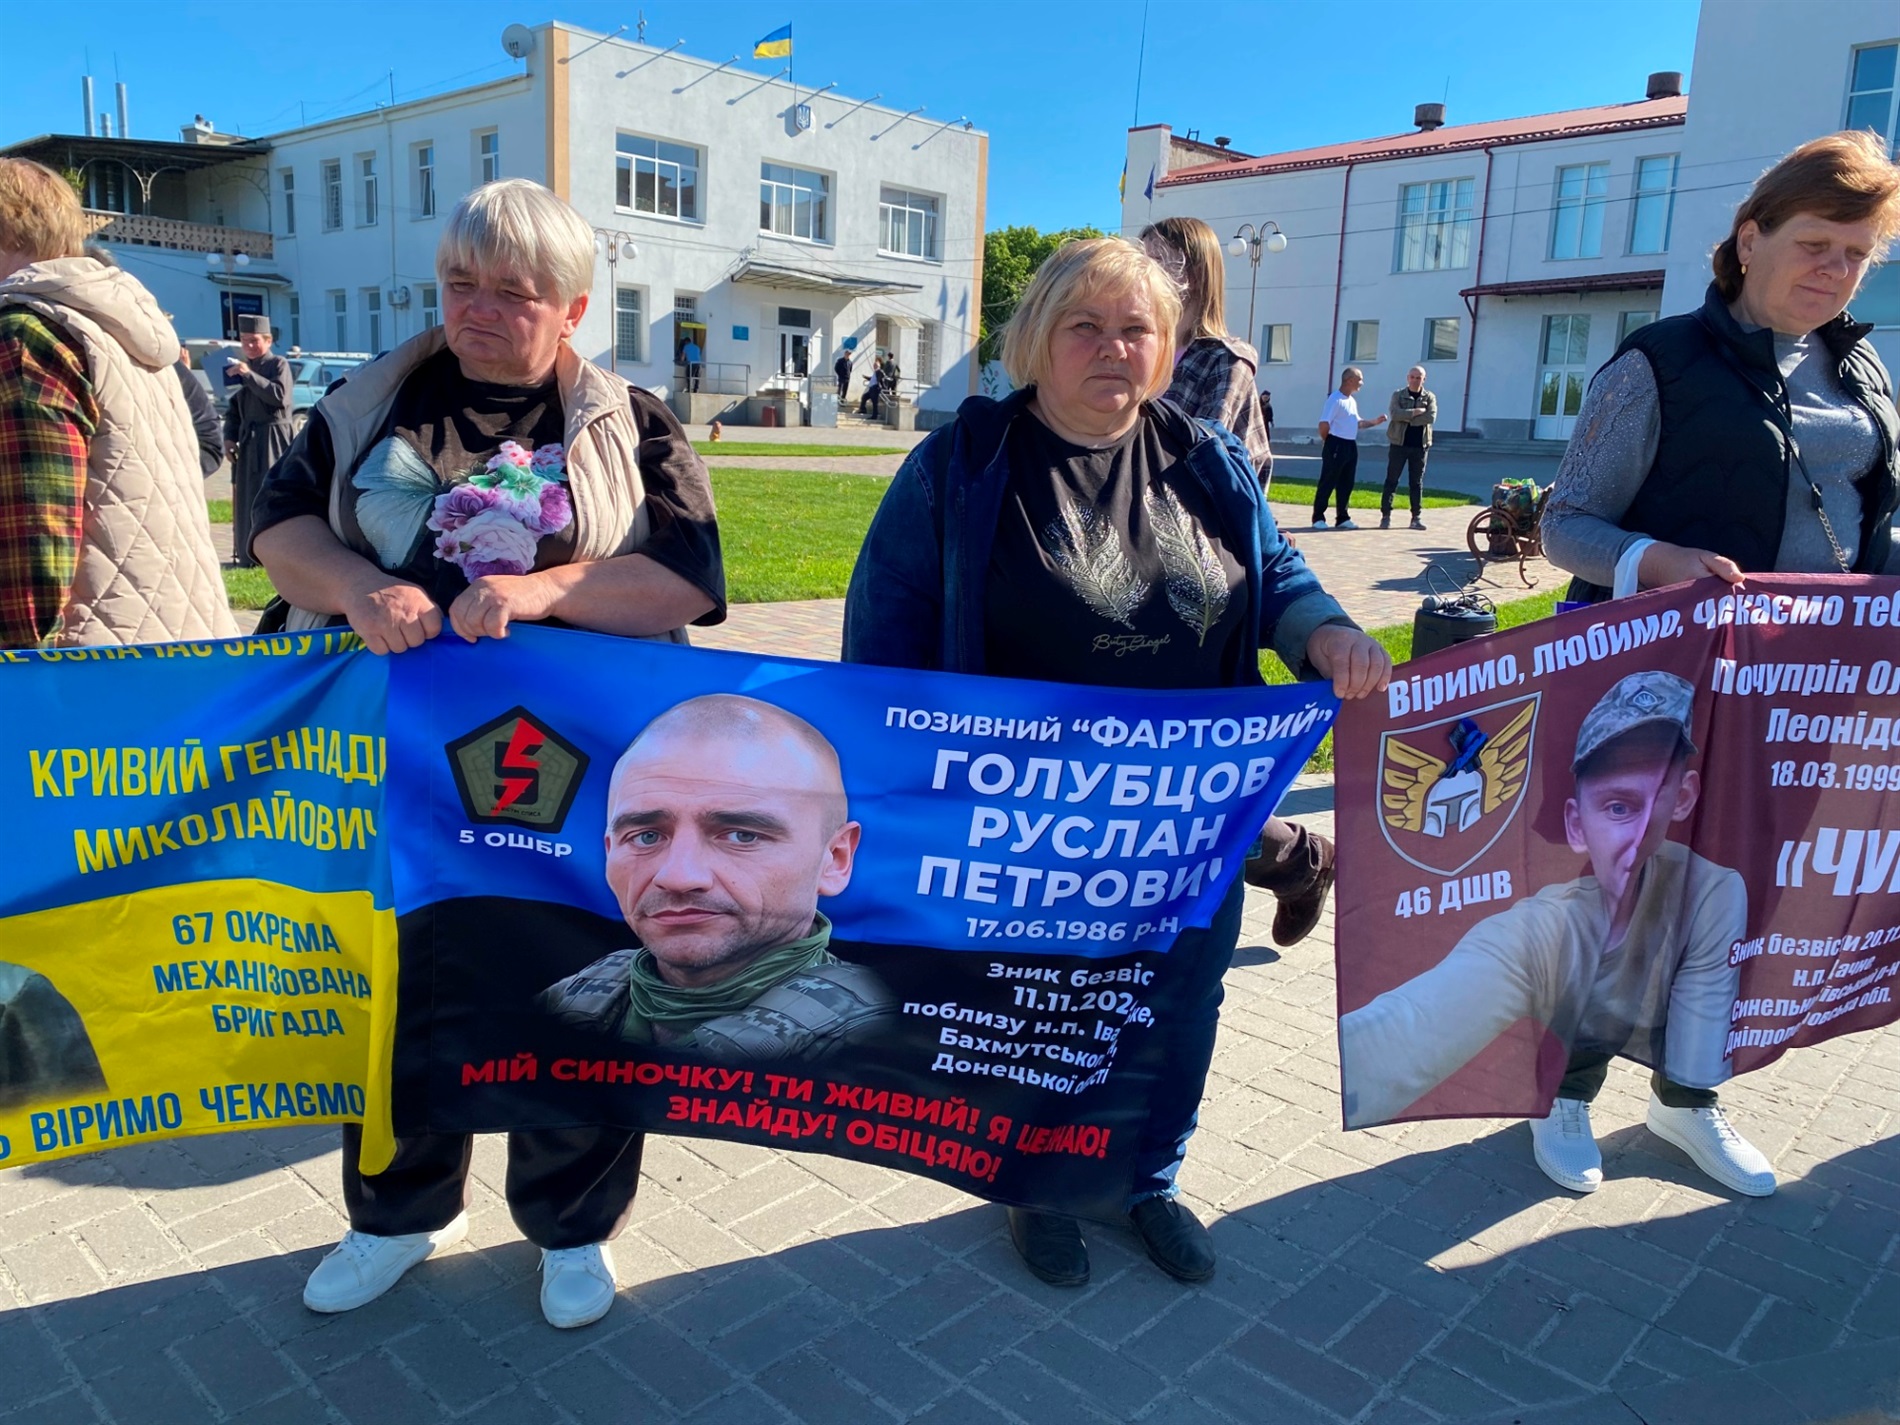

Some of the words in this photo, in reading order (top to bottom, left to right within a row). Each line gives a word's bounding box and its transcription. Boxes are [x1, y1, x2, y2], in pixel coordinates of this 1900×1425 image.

[1388, 653, 1526, 719] Віримо,
[1531, 609, 1684, 678] любимо,
[1693, 594, 1845, 630] чекаємо
[1711, 658, 1862, 697] Почупрін
[885, 706, 1061, 742] ПОЗИВНИЙ
[29, 738, 209, 797] КРИВИЙ
[931, 748, 1276, 812] ГОЛУБЦОВ
[1771, 759, 1900, 792] 18.03.1999
[459, 829, 475, 844] 5
[484, 832, 573, 858] ОШБР
[967, 806, 1226, 859] РУСЛАН
[1776, 827, 1900, 896] «ЧУ
[1395, 886, 1432, 918] 46
[1439, 870, 1513, 915] ДШВ
[172, 911, 214, 945] 67
[226, 910, 341, 954] ОКРЕМА
[966, 917, 1127, 942] 17.06.1986
[1731, 936, 1765, 965] Зник
[1768, 934, 1861, 957] безвіси
[153, 960, 372, 999] МЕХАНІЗОВАНА
[986, 962, 1061, 984] Зник
[1792, 969, 1825, 987] н.п.
[1827, 956, 1876, 980] ачне
[1013, 986, 1138, 1015] 11.11.202
[1858, 986, 1892, 1007] обл.
[212, 1004, 345, 1037] БРИГАДА
[903, 1001, 1026, 1036] поблизу
[1034, 1019, 1085, 1036] н.п.
[931, 1052, 1078, 1094] Донецької
[30, 1092, 183, 1152] ВІРИМО
[200, 1082, 366, 1123] ЧЕКАЄМО
[461, 1052, 538, 1086] МІЙ
[551, 1058, 754, 1093] СИНОЧКУ!
[764, 1073, 814, 1102] ТИ
[824, 1082, 981, 1135] ЖИВИЙ!
[986, 1115, 1013, 1145] Я
[666, 1095, 838, 1139] ЗНАЙДУ!
[845, 1119, 1003, 1183] ОБІЦЯЮ!
